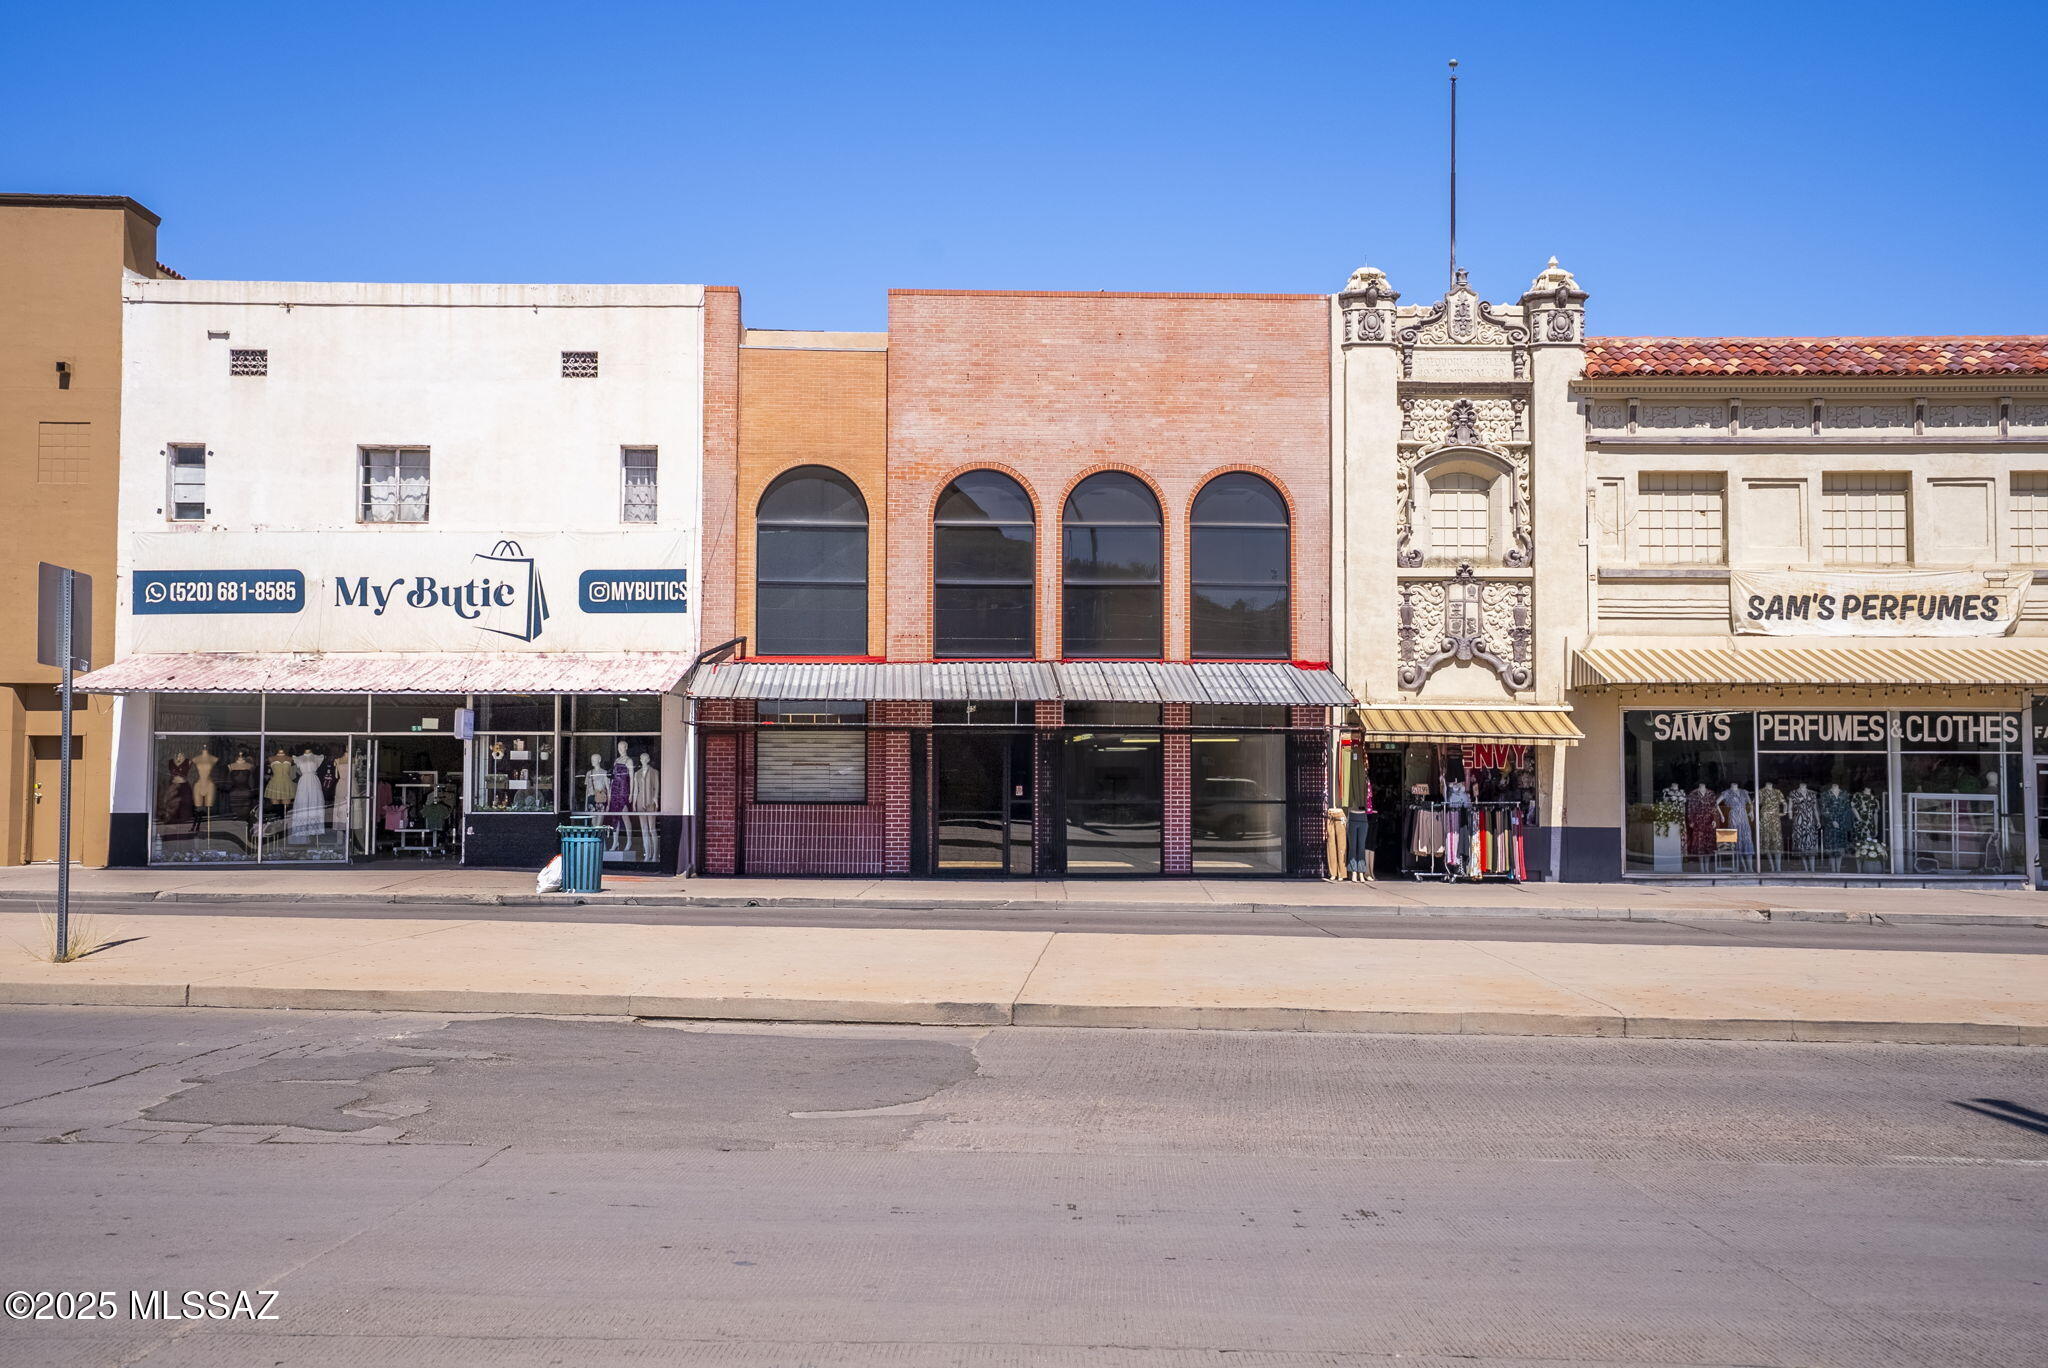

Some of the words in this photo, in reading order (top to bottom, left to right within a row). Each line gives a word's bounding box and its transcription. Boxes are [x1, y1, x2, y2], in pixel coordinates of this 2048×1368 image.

[170, 582, 213, 602] (520)
[217, 581, 296, 601] 681-8585
[334, 576, 405, 616] My
[406, 576, 515, 620] Butic
[611, 581, 687, 601] MYBUTICS
[1747, 593, 1836, 621] SAM'S
[1841, 594, 1999, 621] PERFUMES
[1654, 713, 1731, 742] SAM'S
[1759, 714, 1885, 742] PERFUMES
[1890, 719, 1905, 739] &
[1906, 715, 2019, 743] CLOTHES
[1461, 743, 1528, 769] ENVY
